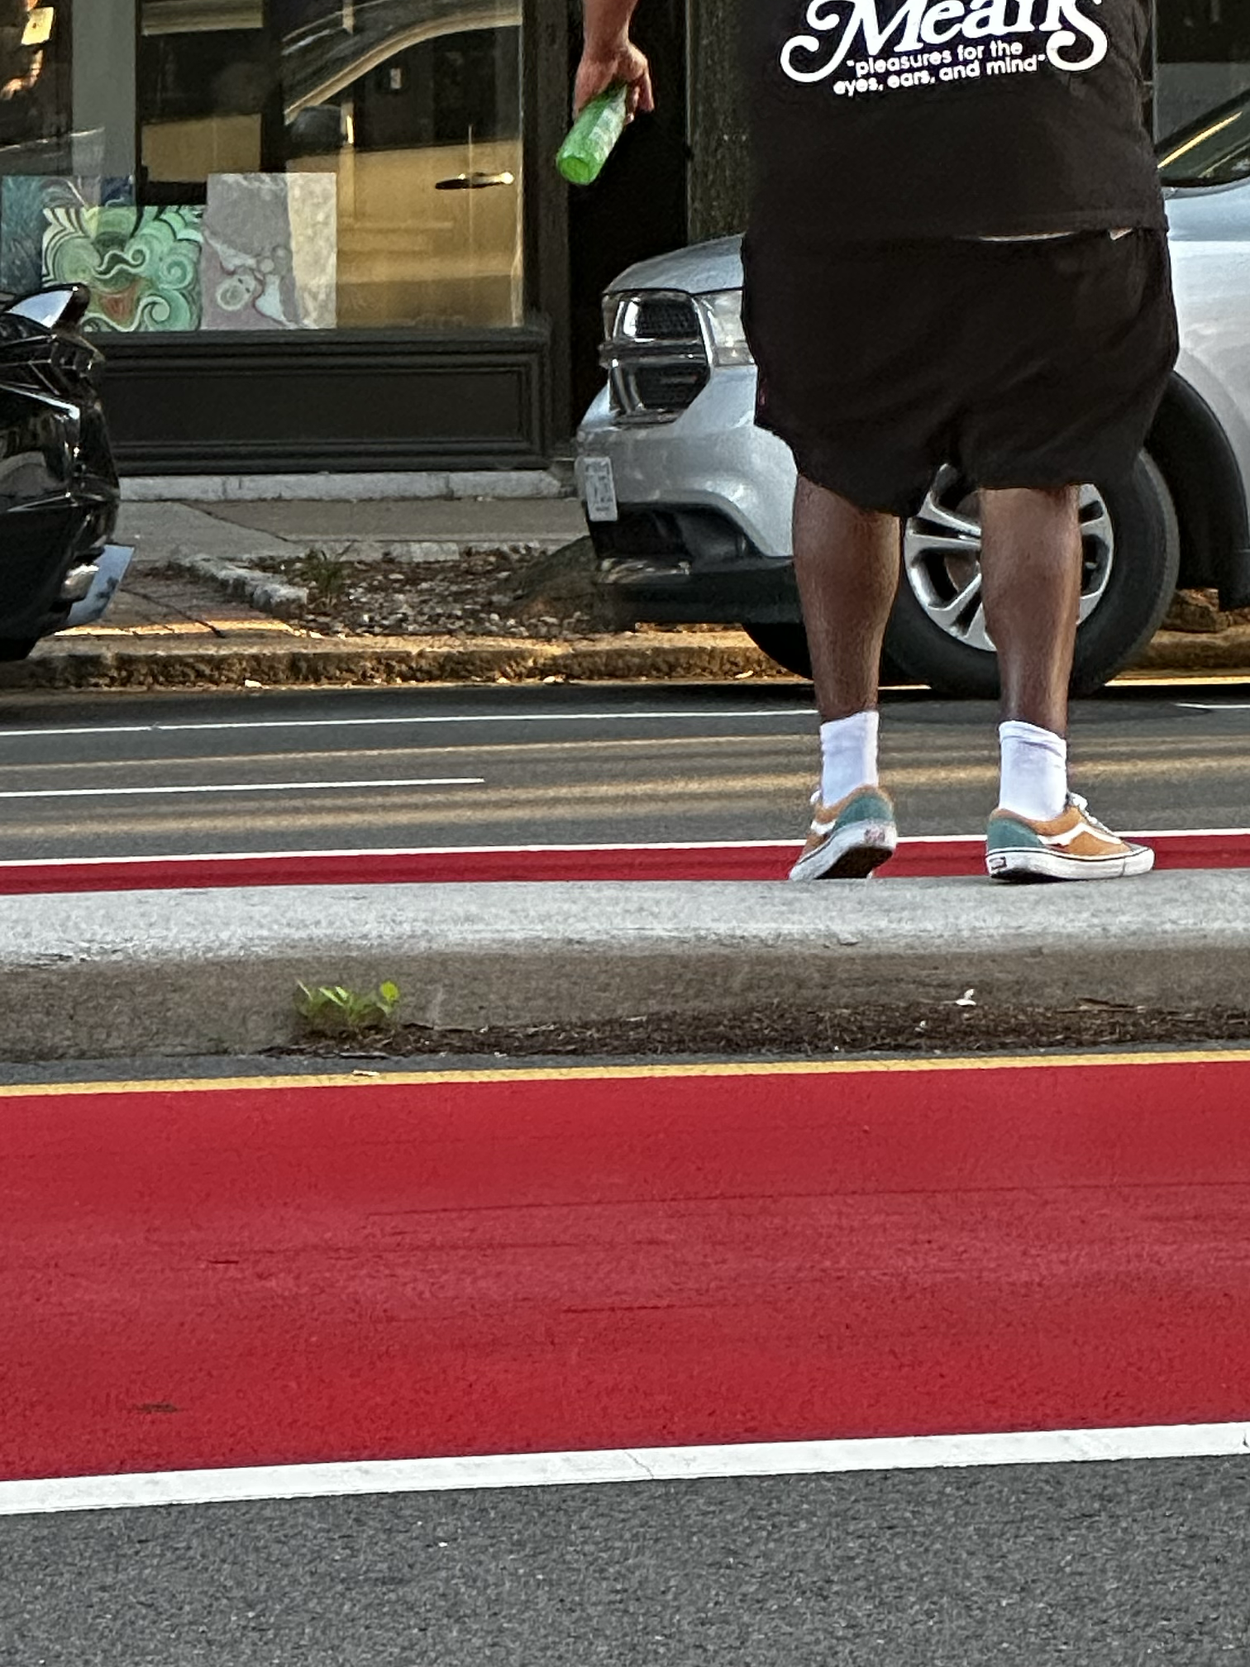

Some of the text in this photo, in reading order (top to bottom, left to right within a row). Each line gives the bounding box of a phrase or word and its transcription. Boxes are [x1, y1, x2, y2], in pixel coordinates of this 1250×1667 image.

[957, 44, 984, 61] for
[990, 40, 1023, 57] the
[938, 62, 981, 81] and
